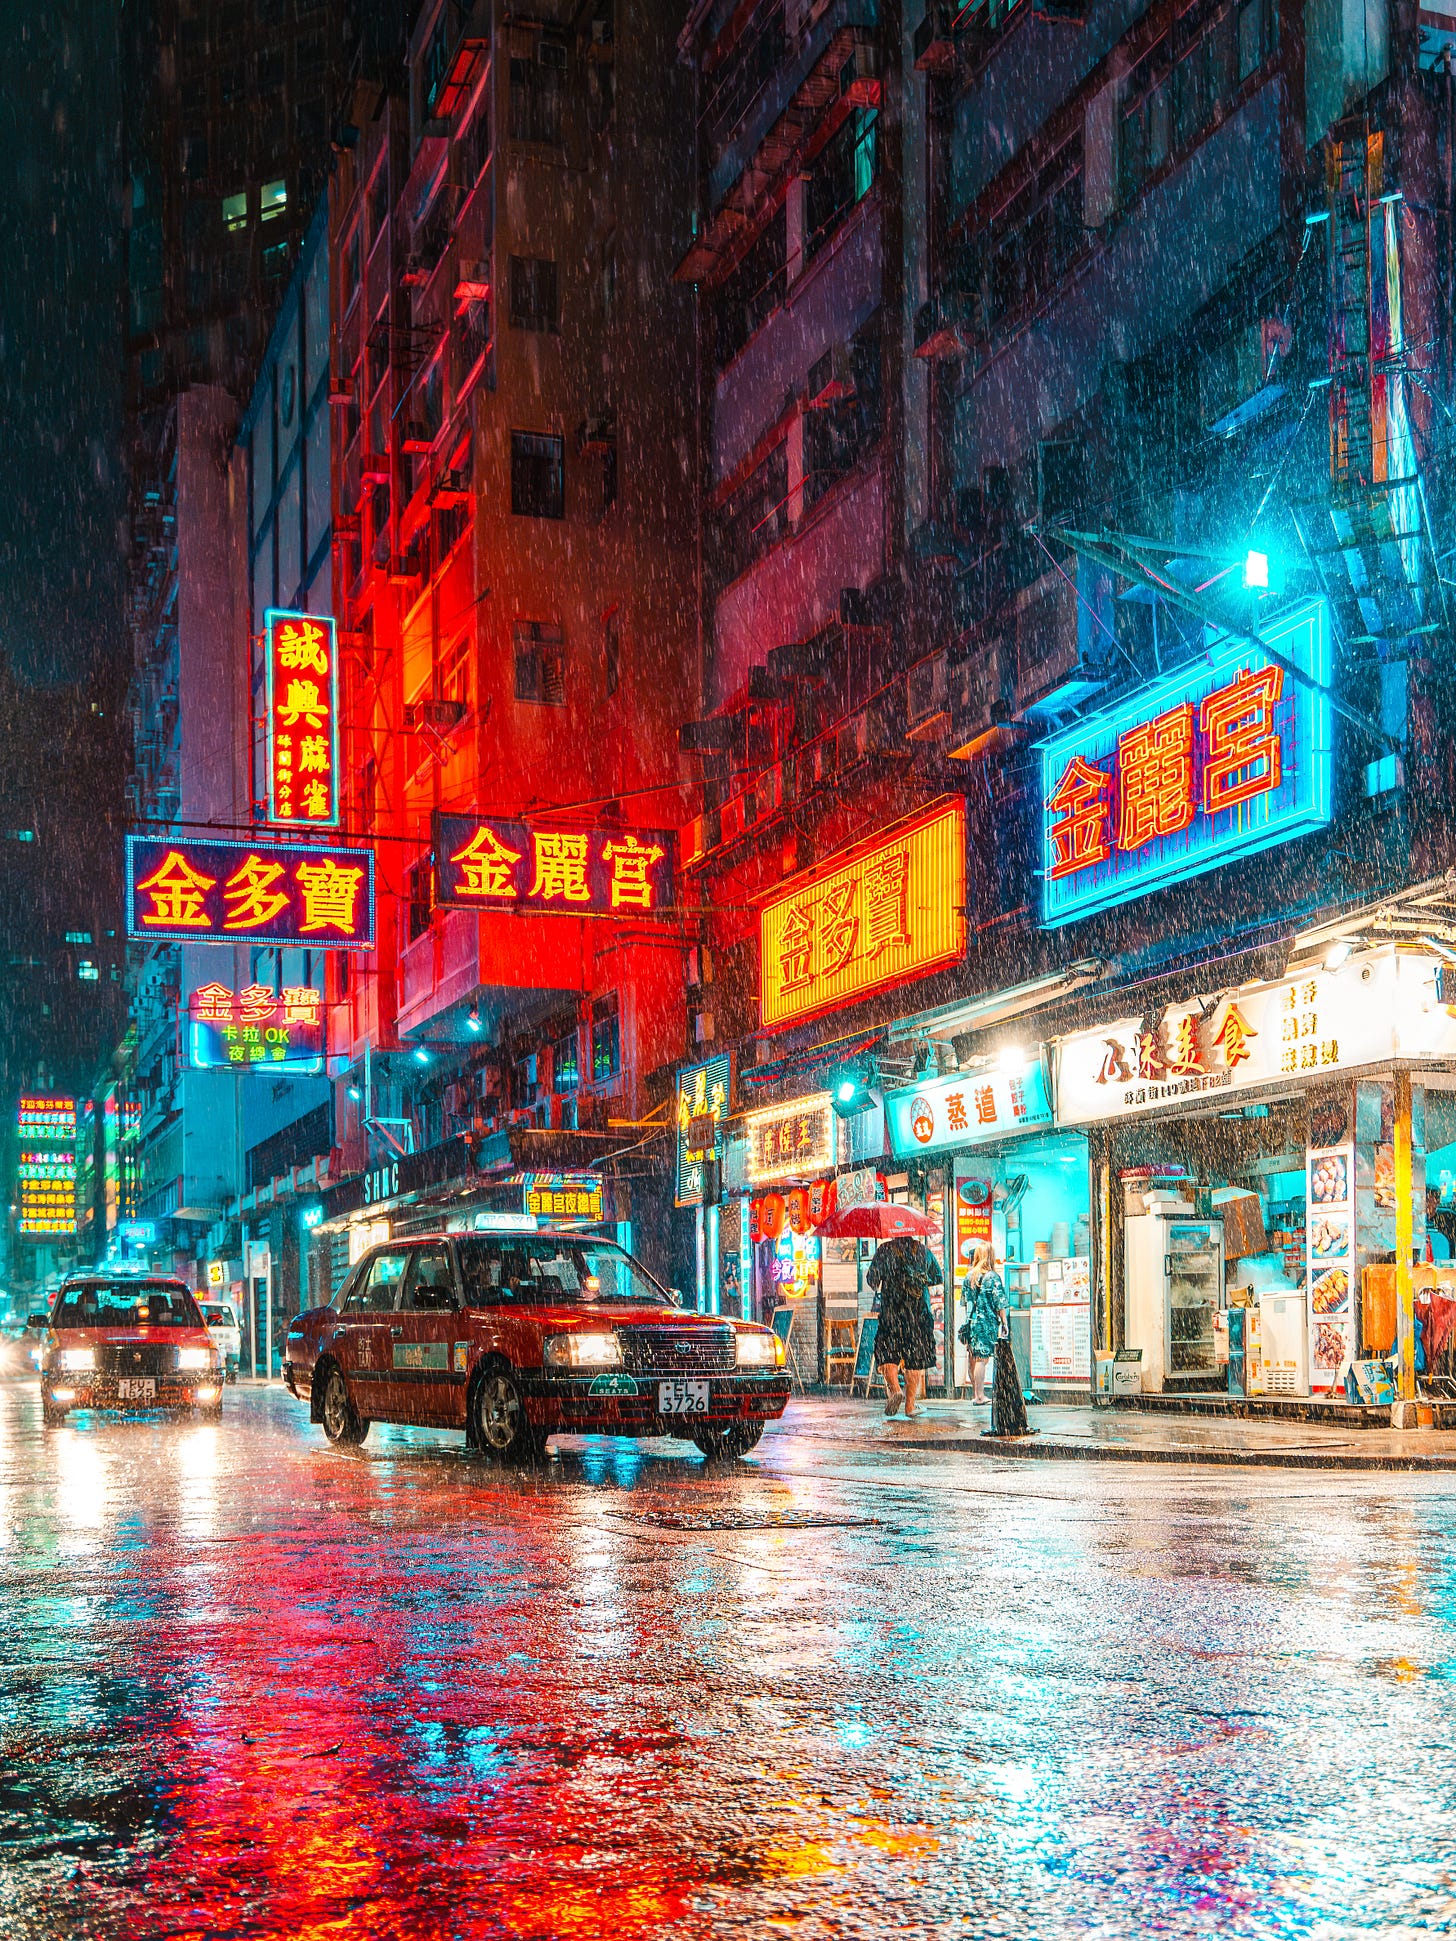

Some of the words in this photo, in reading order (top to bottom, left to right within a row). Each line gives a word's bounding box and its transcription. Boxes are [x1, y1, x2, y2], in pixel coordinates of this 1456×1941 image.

[1044, 664, 1284, 881] 金麗宮
[450, 826, 665, 908] 金麗宮
[136, 850, 366, 934] 金多寶
[776, 850, 911, 997] 金多寶
[196, 982, 320, 1026] 金多寶
[228, 1045, 287, 1062] 夜總會
[945, 1084, 998, 1132] 蒸道
[529, 1192, 601, 1213] 金麗宮夜總會
[609, 1377, 619, 1388] 4
[662, 1396, 706, 1412] 3726
[674, 1383, 695, 1397] EL
